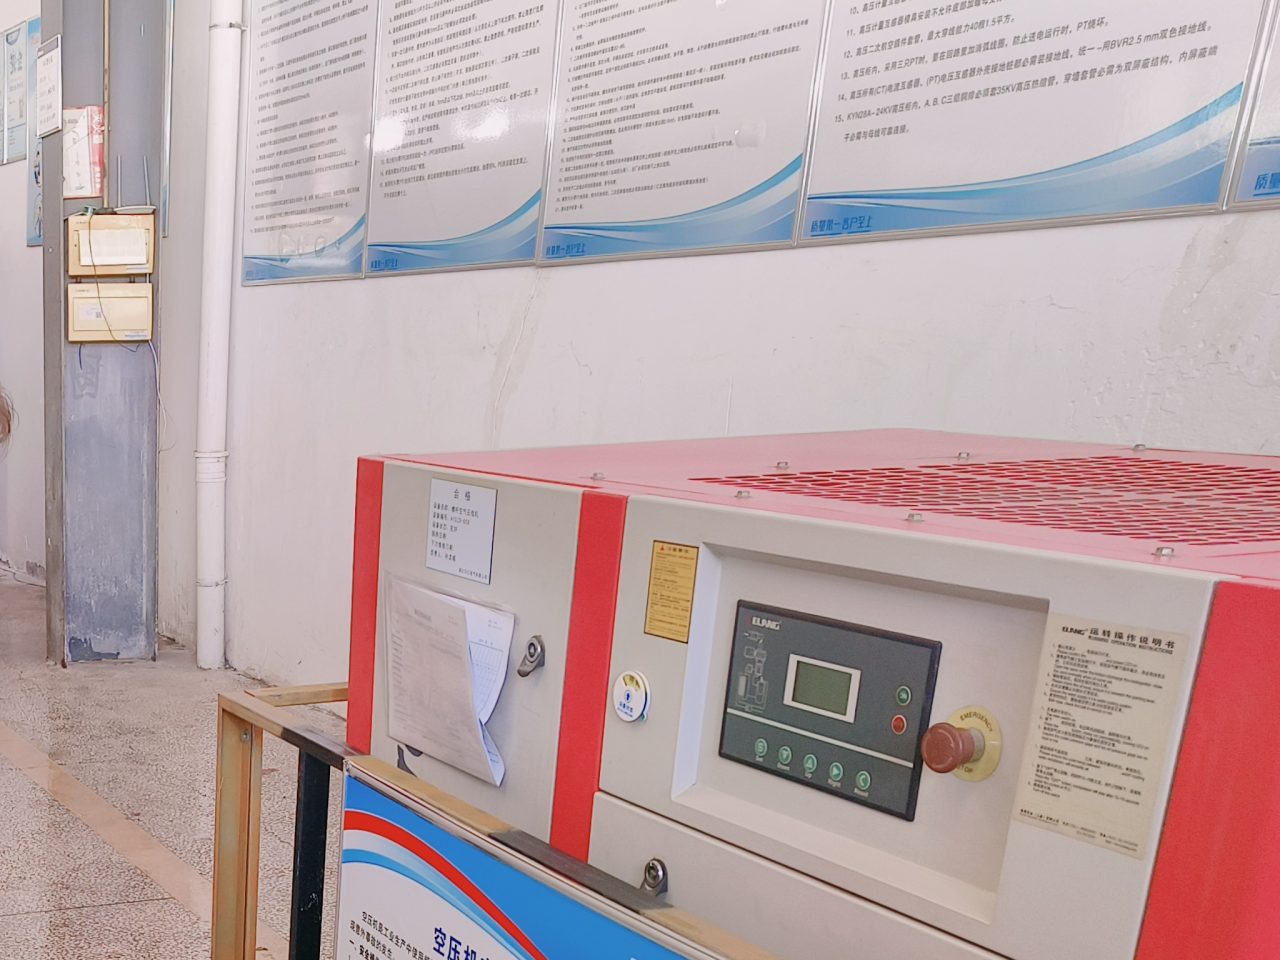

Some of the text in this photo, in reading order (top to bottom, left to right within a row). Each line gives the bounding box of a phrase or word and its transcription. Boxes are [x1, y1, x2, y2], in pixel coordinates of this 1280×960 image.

[1090, 627, 1175, 649] 运转操作说明书
[960, 711, 993, 732] EMERGENCY
